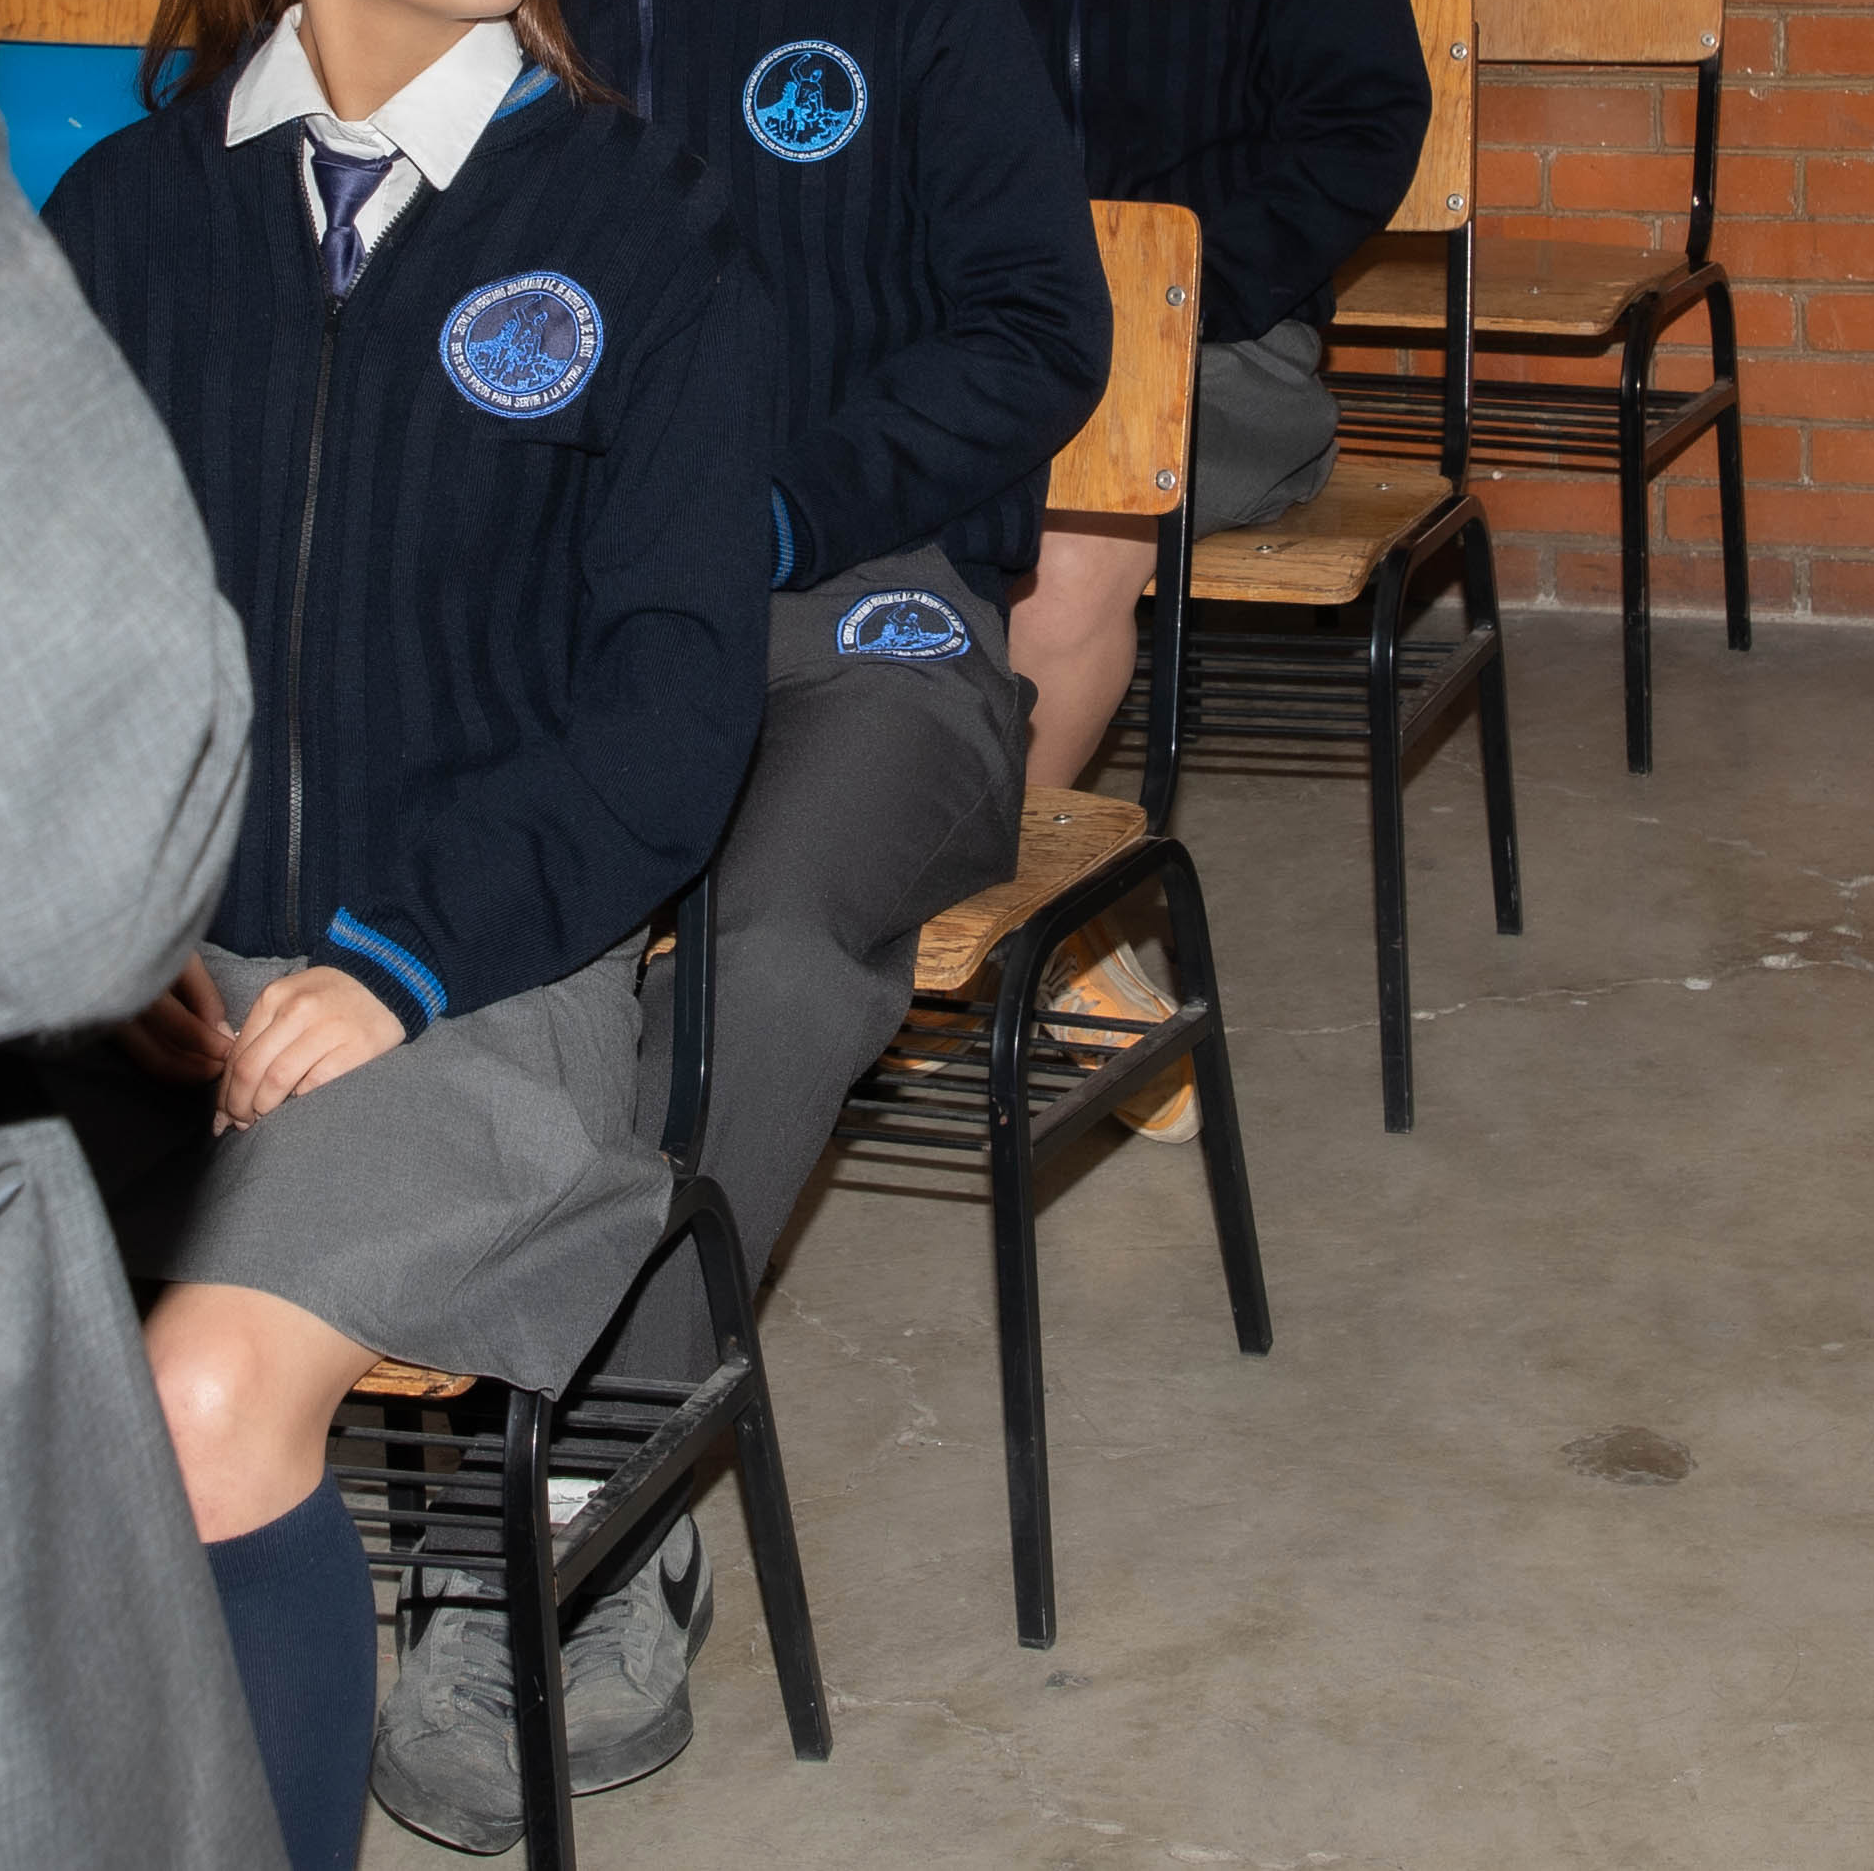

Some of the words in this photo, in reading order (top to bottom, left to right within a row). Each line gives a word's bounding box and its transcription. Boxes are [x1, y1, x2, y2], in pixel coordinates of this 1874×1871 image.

[453, 354, 464, 365] DE
[458, 364, 472, 377] LOS
[559, 365, 584, 392] PATRIA
[467, 375, 490, 398] POCOS
[551, 387, 561, 398] LA
[491, 393, 512, 407] PARA
[514, 396, 541, 408] SERVIR
[543, 393, 550, 403] A
